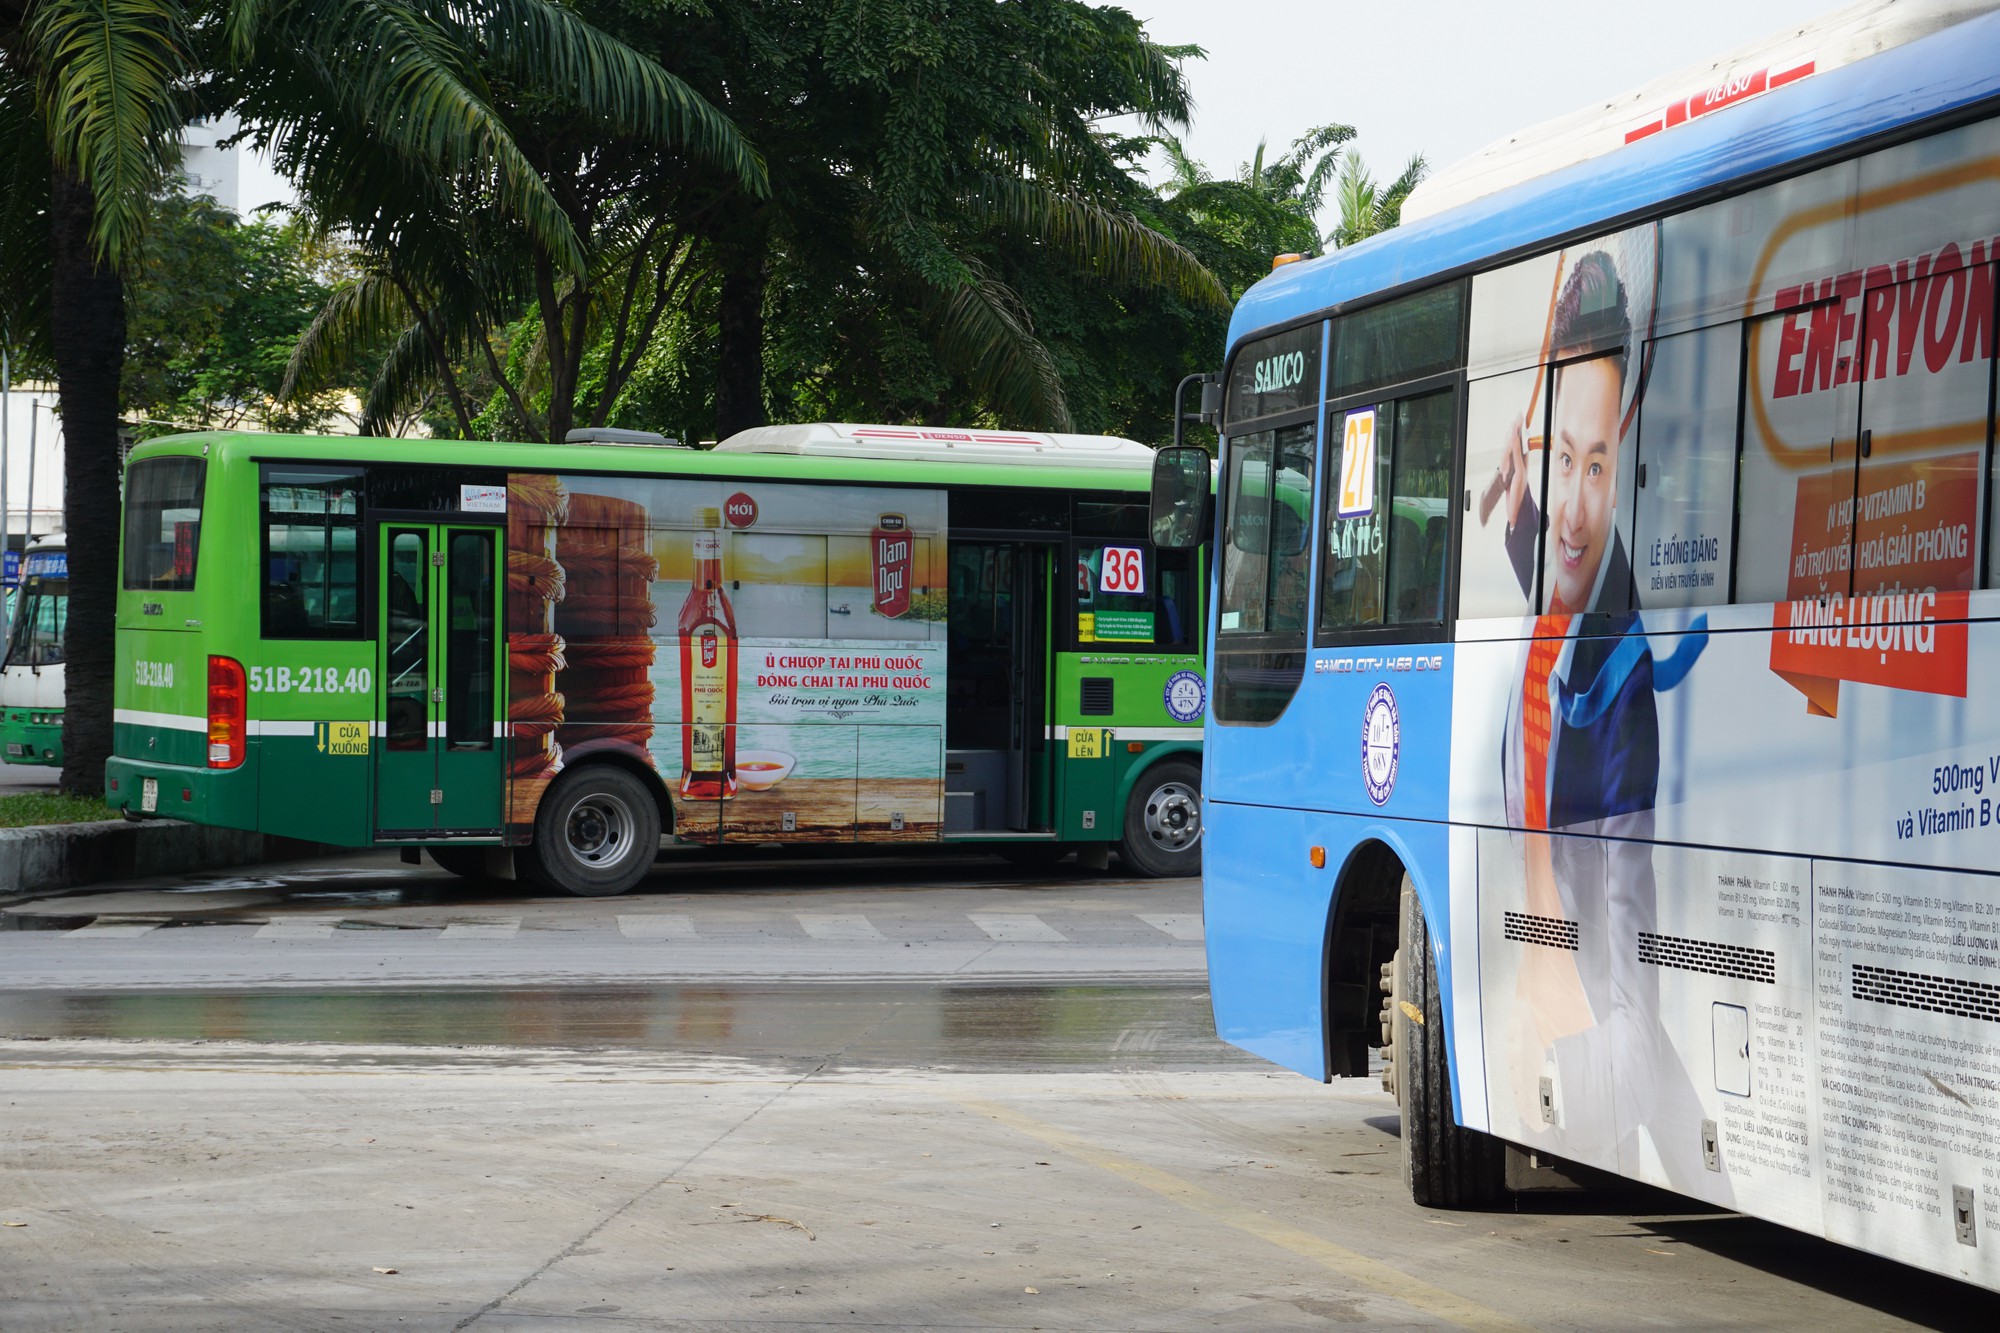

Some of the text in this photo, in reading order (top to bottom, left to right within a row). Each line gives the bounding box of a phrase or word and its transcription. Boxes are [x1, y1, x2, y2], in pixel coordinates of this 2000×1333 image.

[1705, 74, 1751, 106] DENSO
[1255, 351, 1304, 394] SAMCO
[1343, 417, 1373, 509] 27
[729, 502, 753, 516] MỚI
[1864, 483, 1913, 522] VITAMIN
[1915, 479, 1925, 510] B
[879, 538, 907, 565] Nam
[1650, 533, 1718, 567] LÊ HỒNG ĐĂNG
[1794, 542, 1806, 578] HỖ
[1860, 532, 1884, 569] HOÁ
[1886, 525, 1912, 566] GIẢI
[1914, 520, 1967, 563] PHÓNG
[1105, 549, 1140, 591] 36
[879, 566, 904, 605] Ngư
[1788, 581, 1936, 665] NĂNG LƯỢNG
[136, 660, 174, 688] 51B-218.40
[766, 652, 923, 671] Ủ CHƯỢP TẠI PHÚ QUỐC
[1080, 656, 1130, 665] SAMCO
[1134, 657, 1166, 665] CITY
[1314, 658, 1353, 674] SAMCO
[1356, 657, 1383, 673] CITY
[1415, 655, 1442, 671] CNG
[249, 666, 371, 693] 51B-218.40
[757, 672, 931, 691] ĐÓNG CHAI TẠI PHÚ QUỐC
[769, 694, 919, 709] Gói trọn vị ngon Phú Quốc
[339, 723, 361, 738] CỬA
[1075, 729, 1094, 743] CỬA
[331, 737, 368, 754] XUỐNG
[1075, 745, 1093, 757] LÊN
[1933, 764, 1984, 795] 500mg
[1897, 798, 1991, 840] và Vitamin B
[1718, 874, 1735, 887] THÀNH
[1753, 879, 1770, 890] Vitamin
[1780, 882, 1788, 892] 500
[1718, 890, 1734, 901] Vitamin
[1758, 896, 1775, 907] Vitamin
[1718, 906, 1734, 917] Vitamin
[1819, 885, 1837, 898] THÀNH
[1855, 889, 1874, 902] Vitamin
[1882, 893, 1891, 904] 500
[1903, 895, 1923, 908] Vitamin
[1934, 898, 1941, 909] 50
[1975, 902, 1985, 914] B2:
[1986, 904, 1994, 915] 20
[1819, 902, 1837, 913] Vitamin
[1904, 912, 1911, 923] 20
[1923, 913, 1943, 927] Vitamin
[1969, 919, 1990, 932] Vitamin
[1840, 920, 1856, 932] Silicon
[1878, 925, 1907, 940] Magnesium
[1967, 936, 1989, 951] LƯỢNG
[1990, 937, 1999, 951] VÀ
[1819, 950, 1837, 962] Vitamin
